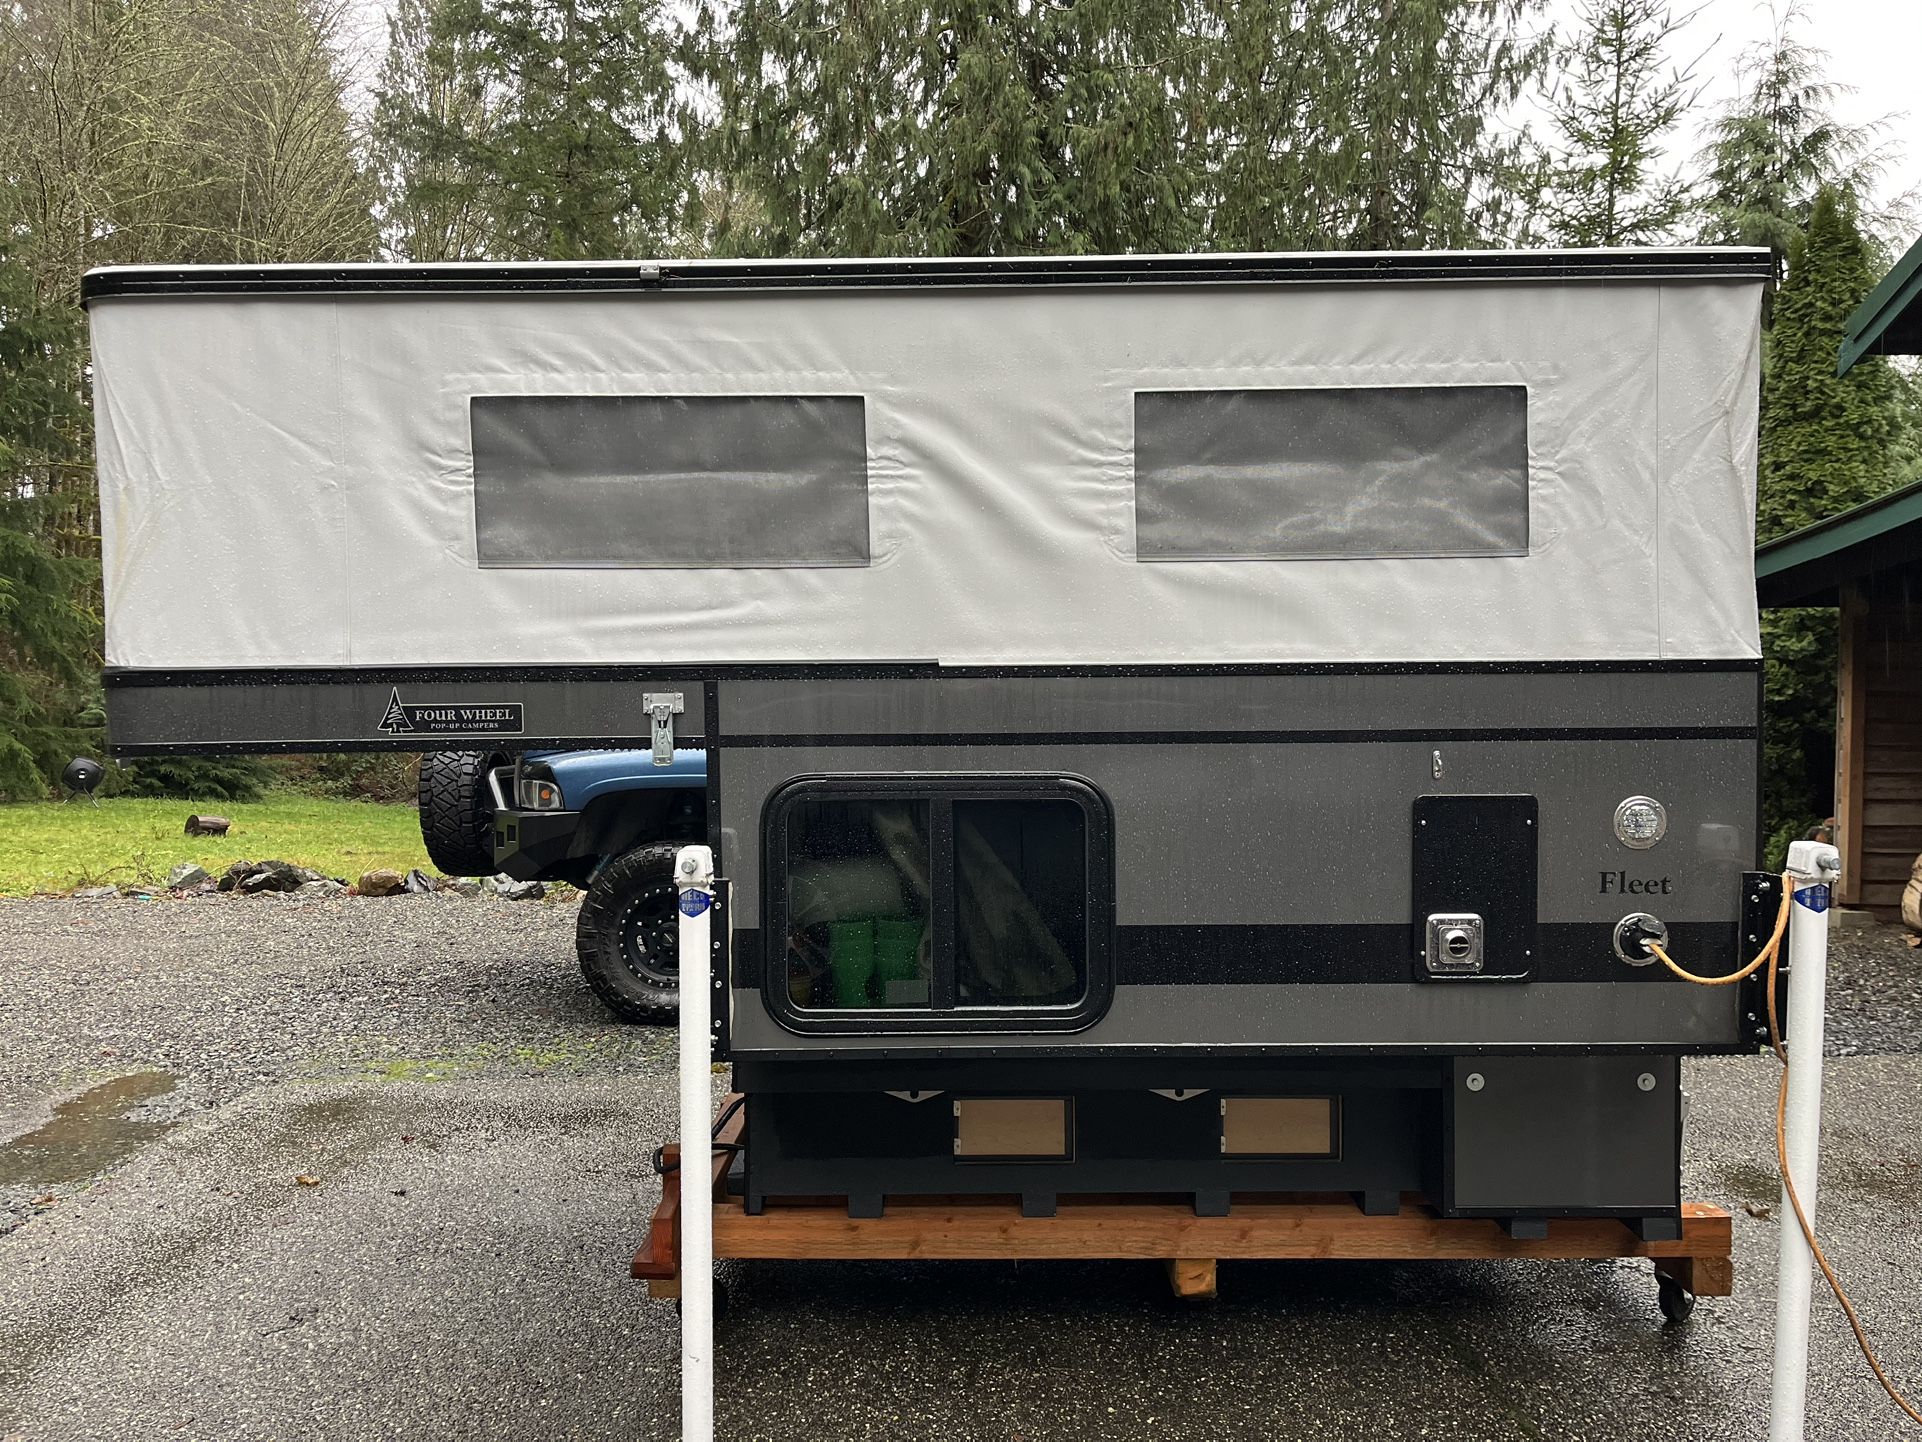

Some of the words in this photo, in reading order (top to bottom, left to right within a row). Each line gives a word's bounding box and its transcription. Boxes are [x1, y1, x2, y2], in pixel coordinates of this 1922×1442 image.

[415, 709, 457, 721] FOUR
[459, 709, 514, 720] WHEEL
[1599, 870, 1672, 894] Fleet
